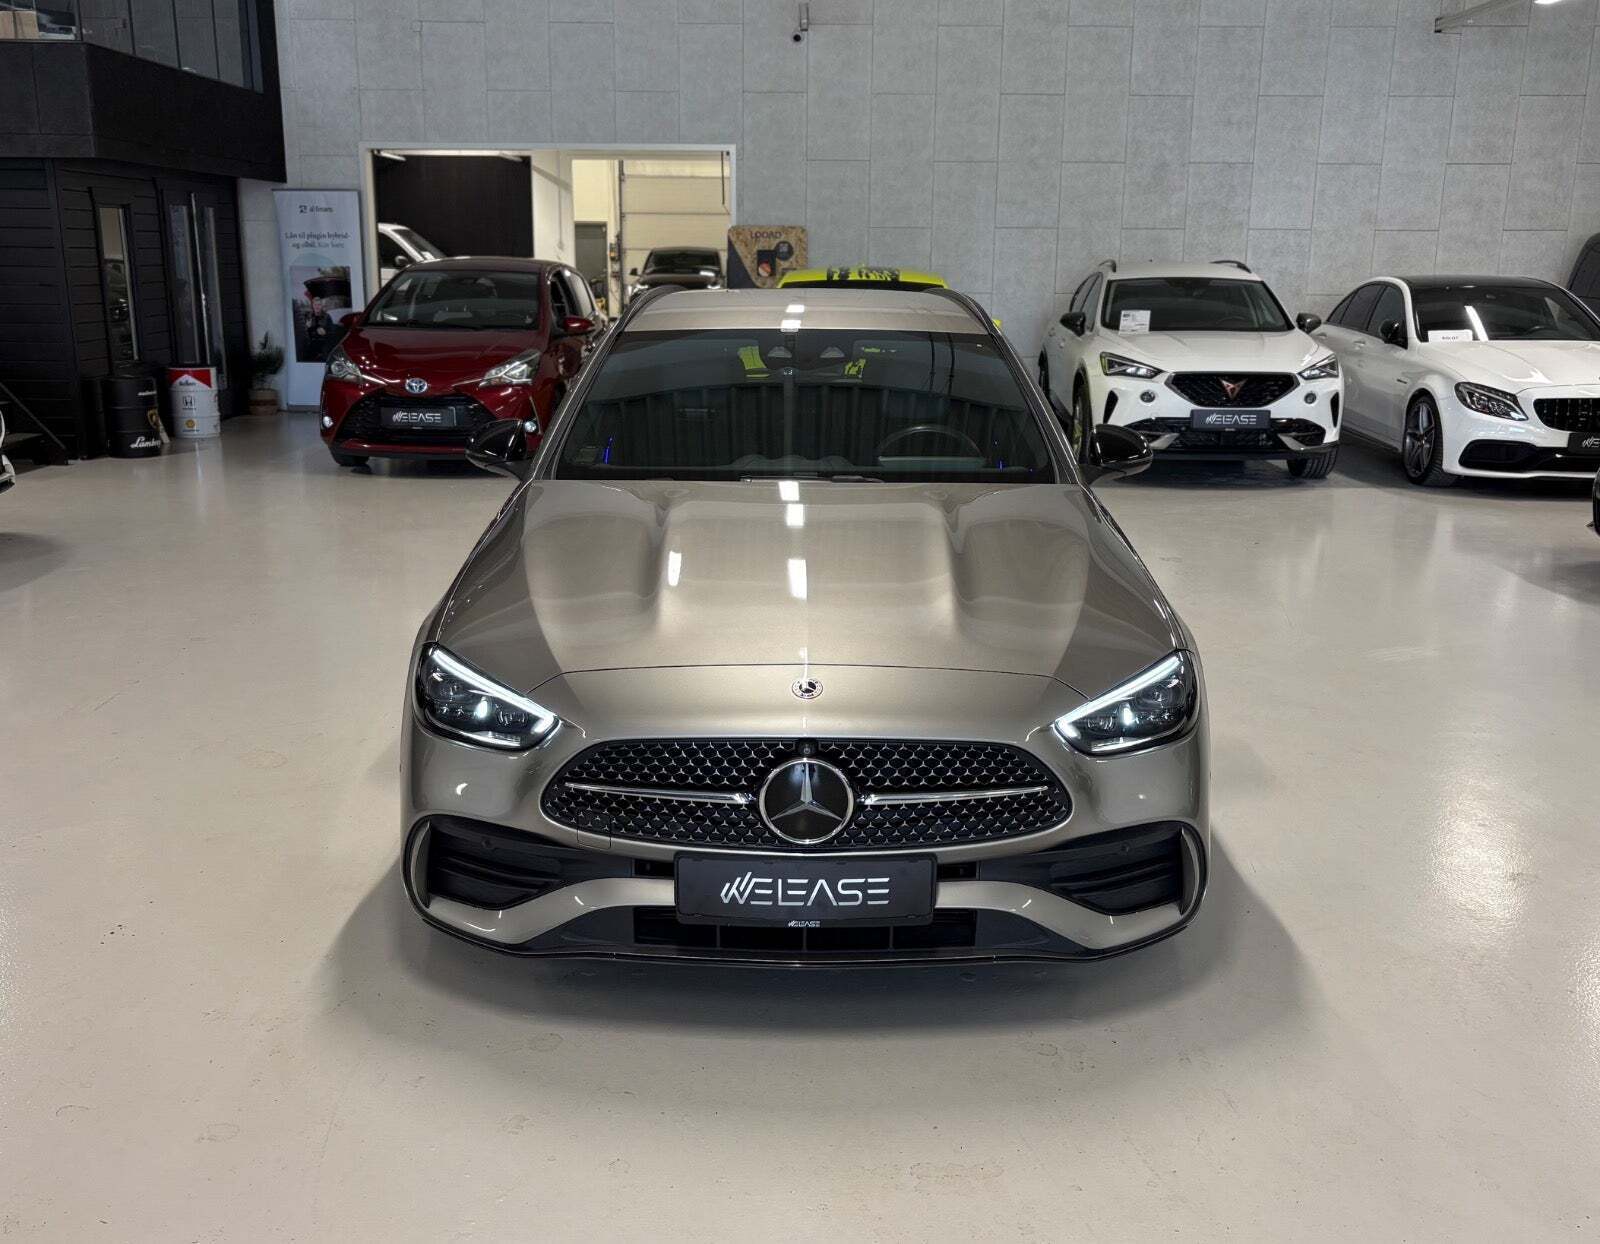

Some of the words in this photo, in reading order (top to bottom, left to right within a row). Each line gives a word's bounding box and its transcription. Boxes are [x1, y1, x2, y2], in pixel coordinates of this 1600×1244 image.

[392, 410, 442, 423] WELEASE
[1205, 413, 1257, 425] WELEASE
[720, 871, 891, 907] WELEASE
[787, 920, 821, 928] WELEASE
